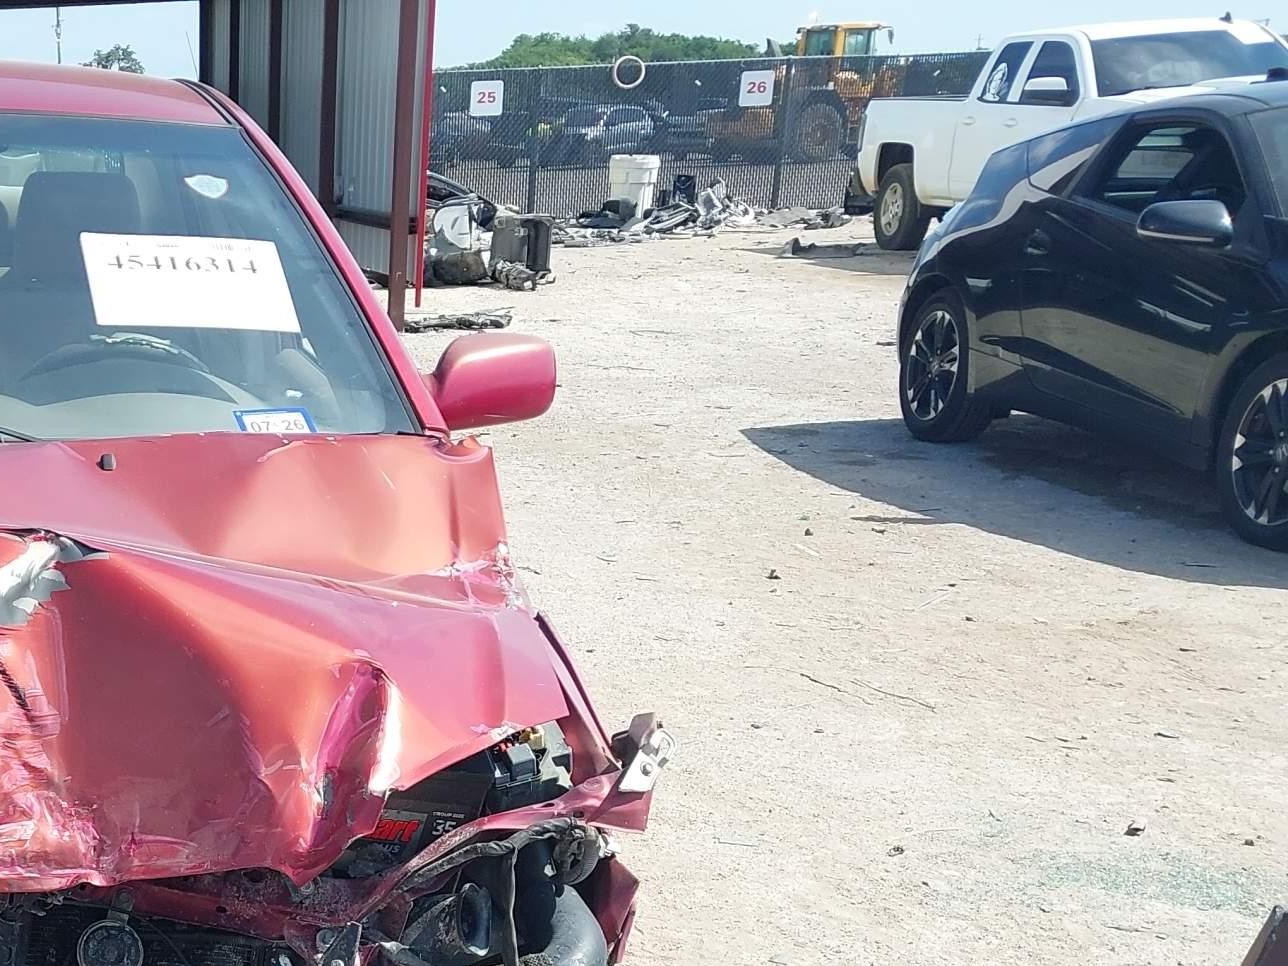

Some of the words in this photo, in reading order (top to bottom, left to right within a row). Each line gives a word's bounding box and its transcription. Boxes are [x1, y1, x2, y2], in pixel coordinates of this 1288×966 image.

[746, 81, 767, 94] 26
[476, 91, 497, 104] 25
[107, 254, 258, 274] 45416314
[250, 420, 270, 433] 07
